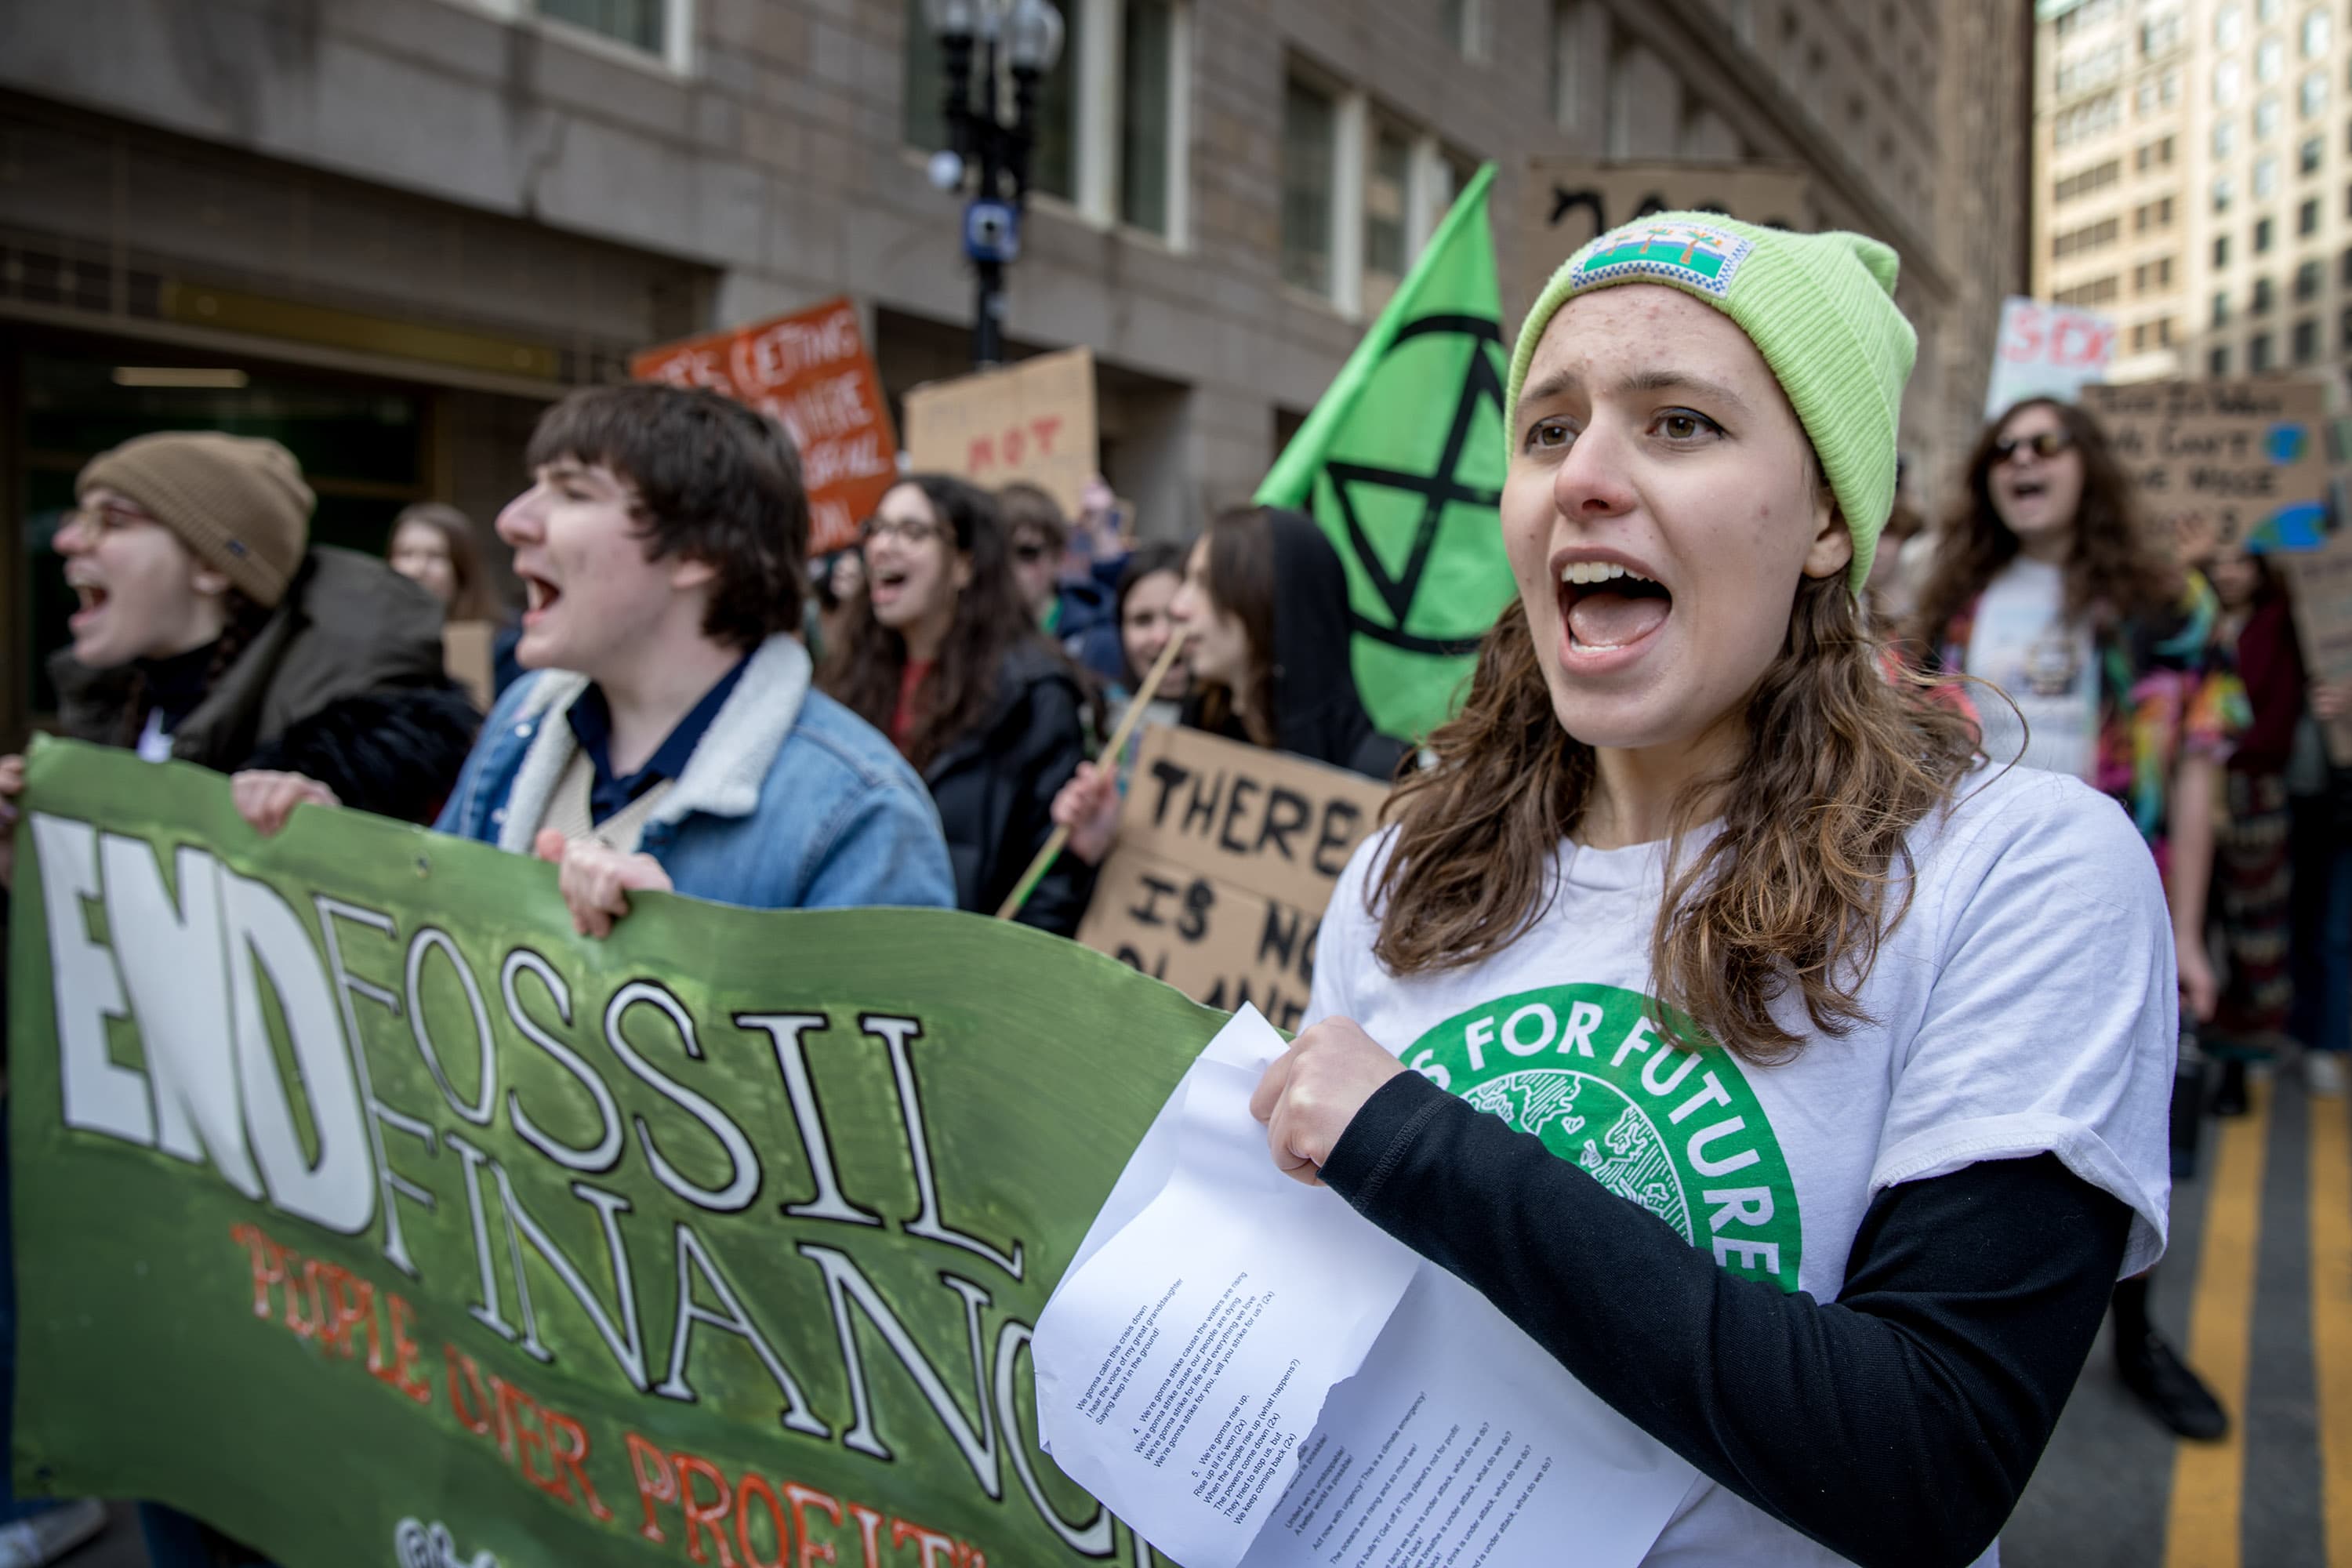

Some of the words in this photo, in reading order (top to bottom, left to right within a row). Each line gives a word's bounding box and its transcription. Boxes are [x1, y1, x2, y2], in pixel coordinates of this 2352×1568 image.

[1150, 760, 1363, 877] THERE
[1127, 876, 1217, 943] IS
[30, 811, 376, 1233] END
[313, 892, 1024, 1280] FOSSIL
[1465, 1001, 1603, 1071] FOR
[1610, 1017, 1780, 1275] FUTURE
[229, 1222, 432, 1404] PEOPLE
[443, 1341, 614, 1522] OVER
[367, 1095, 1154, 1568] FINANC
[1076, 1398, 1088, 1410] We
[1085, 1376, 1102, 1400] gonna
[1098, 1358, 1113, 1377] calm
[1109, 1345, 1122, 1359] this
[1119, 1325, 1134, 1345] crisis
[1131, 1305, 1149, 1325] down
[1087, 1397, 1102, 1415] hear
[1098, 1385, 1110, 1398] the
[1106, 1366, 1123, 1385] voice
[1119, 1356, 1127, 1367] of
[1124, 1345, 1136, 1358] my
[1132, 1325, 1149, 1347] great
[1145, 1279, 1182, 1327] granddaughter
[1095, 1400, 1116, 1425] Saying
[1109, 1382, 1126, 1402] keep
[1126, 1369, 1134, 1377] in
[1130, 1356, 1142, 1370] the
[1139, 1327, 1160, 1358] ground!
[1134, 1432, 1152, 1454] We're
[1149, 1410, 1166, 1435] gonna
[1163, 1389, 1179, 1410] strike
[1175, 1367, 1193, 1390] cause
[1190, 1353, 1201, 1367] our
[1199, 1328, 1218, 1356] people
[1216, 1316, 1228, 1329] are
[1225, 1297, 1243, 1316] dying
[1138, 1401, 1157, 1422] We're
[1154, 1377, 1172, 1403] gonna
[1168, 1357, 1185, 1379] strike
[1182, 1334, 1200, 1358] cause
[1196, 1322, 1209, 1335] the
[1205, 1299, 1225, 1322] waters
[1222, 1287, 1234, 1300] are
[1231, 1271, 1248, 1289] rising
[1143, 1439, 1162, 1461] We're
[1158, 1417, 1176, 1442] gonna
[1172, 1396, 1189, 1417] strike
[1184, 1385, 1196, 1397] for
[1191, 1374, 1203, 1386] life
[1200, 1357, 1214, 1374] and
[1210, 1320, 1240, 1359] everything
[1235, 1309, 1246, 1321] we
[1241, 1295, 1257, 1311] love
[1153, 1446, 1171, 1468] We're
[1168, 1424, 1186, 1449] gonna
[1182, 1403, 1199, 1425] strike
[1194, 1392, 1205, 1404] for
[1202, 1377, 1217, 1394] you,
[1213, 1361, 1225, 1376] will
[1221, 1348, 1235, 1364] you
[1231, 1327, 1248, 1348] strike
[1243, 1316, 1255, 1328] for
[1252, 1302, 1263, 1318] us?
[1261, 1290, 1275, 1305] (2x)
[1192, 1479, 1209, 1497] Rise
[1205, 1469, 1215, 1480] up
[1217, 1450, 1227, 1462] it's
[1223, 1434, 1237, 1450] won
[1232, 1418, 1248, 1436] (2x)
[1198, 1443, 1217, 1465] We're
[1214, 1420, 1232, 1445] gonna
[1229, 1406, 1241, 1421] rise
[1203, 1482, 1221, 1504] When
[1217, 1469, 1229, 1483] the
[1226, 1445, 1245, 1472] people
[1242, 1430, 1254, 1446] rise
[1251, 1419, 1261, 1431] up
[1258, 1397, 1276, 1421] (what
[1270, 1358, 1301, 1399] happens?)
[1212, 1496, 1228, 1510] The
[1224, 1469, 1244, 1497] powers
[1241, 1449, 1258, 1470] come
[1254, 1428, 1271, 1450] down
[1266, 1412, 1281, 1429] (2x)
[1222, 1498, 1240, 1518] They
[1236, 1481, 1250, 1500] tried
[1246, 1474, 1256, 1483] to
[1252, 1457, 1266, 1475] stop
[1269, 1432, 1283, 1446] but
[1232, 1512, 1247, 1525] We
[1241, 1493, 1258, 1512] keep
[1254, 1467, 1276, 1494] coming
[1270, 1448, 1287, 1468] back
[1283, 1432, 1298, 1450] (2x)
